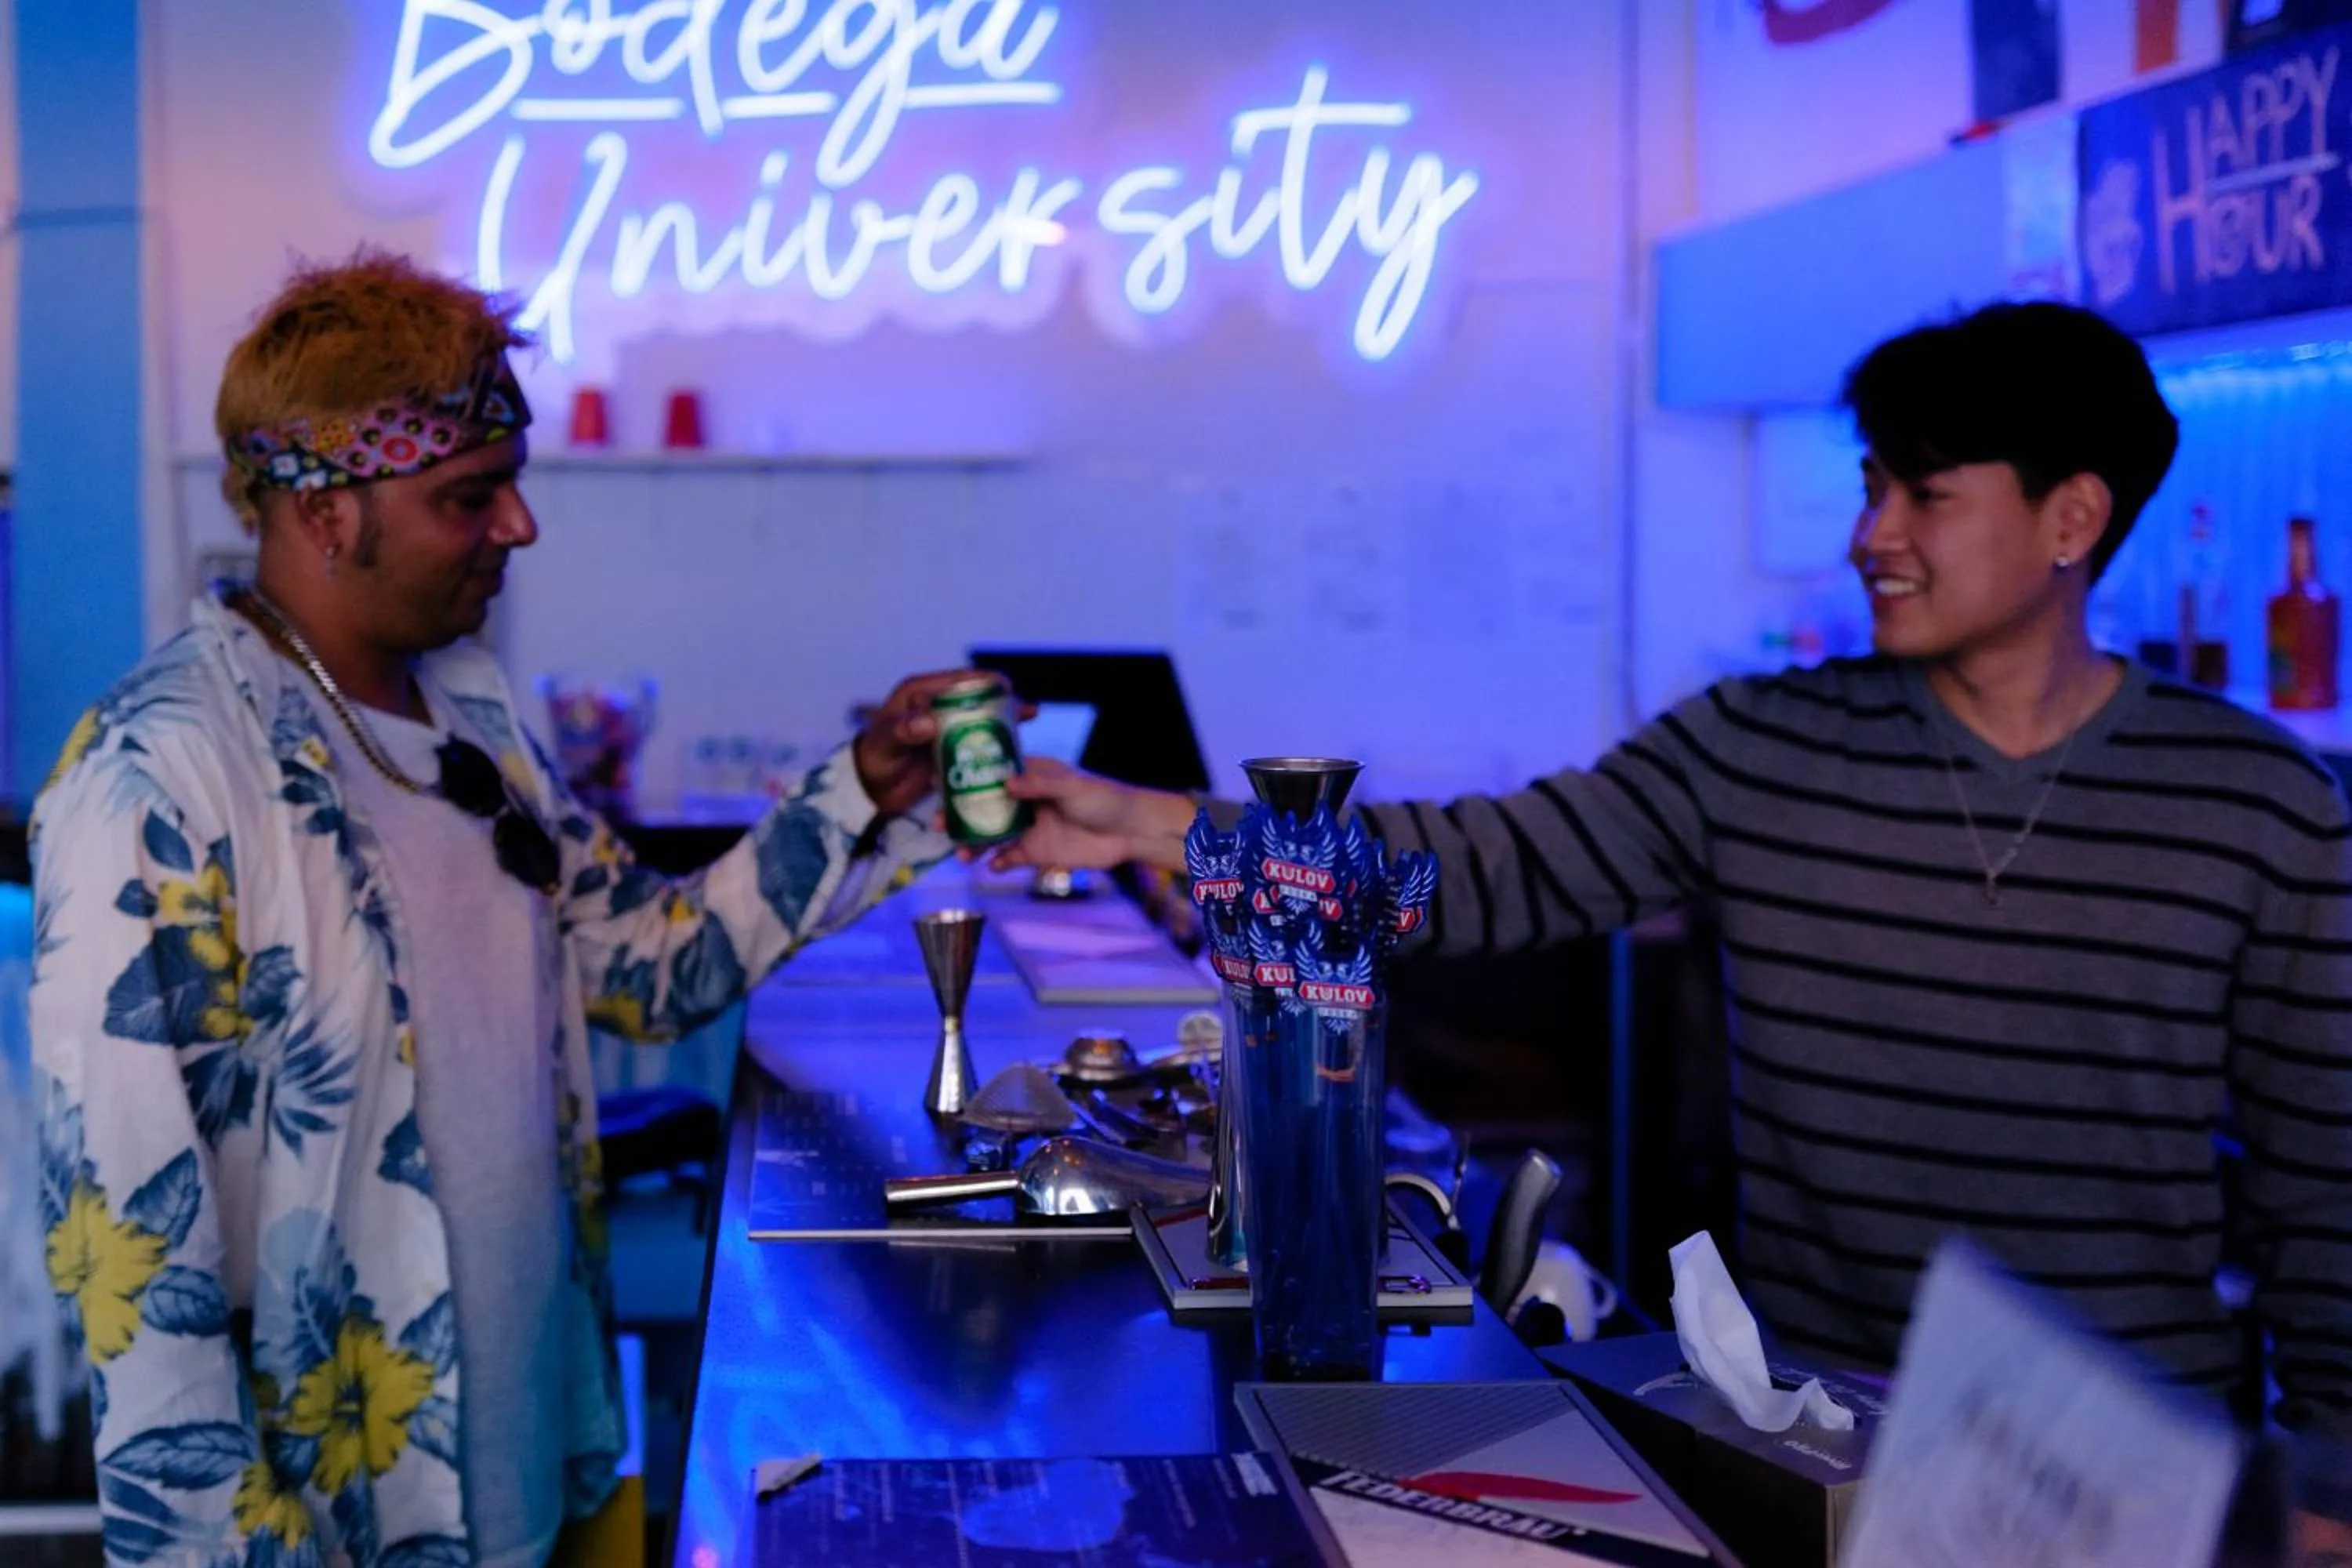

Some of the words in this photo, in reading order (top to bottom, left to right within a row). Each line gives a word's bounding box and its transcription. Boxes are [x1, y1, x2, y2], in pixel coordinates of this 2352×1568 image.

[475, 64, 1480, 362] University
[2154, 107, 2323, 294] HOUR
[1268, 862, 1330, 888] KULOV
[1307, 985, 1368, 1003] KULOV
